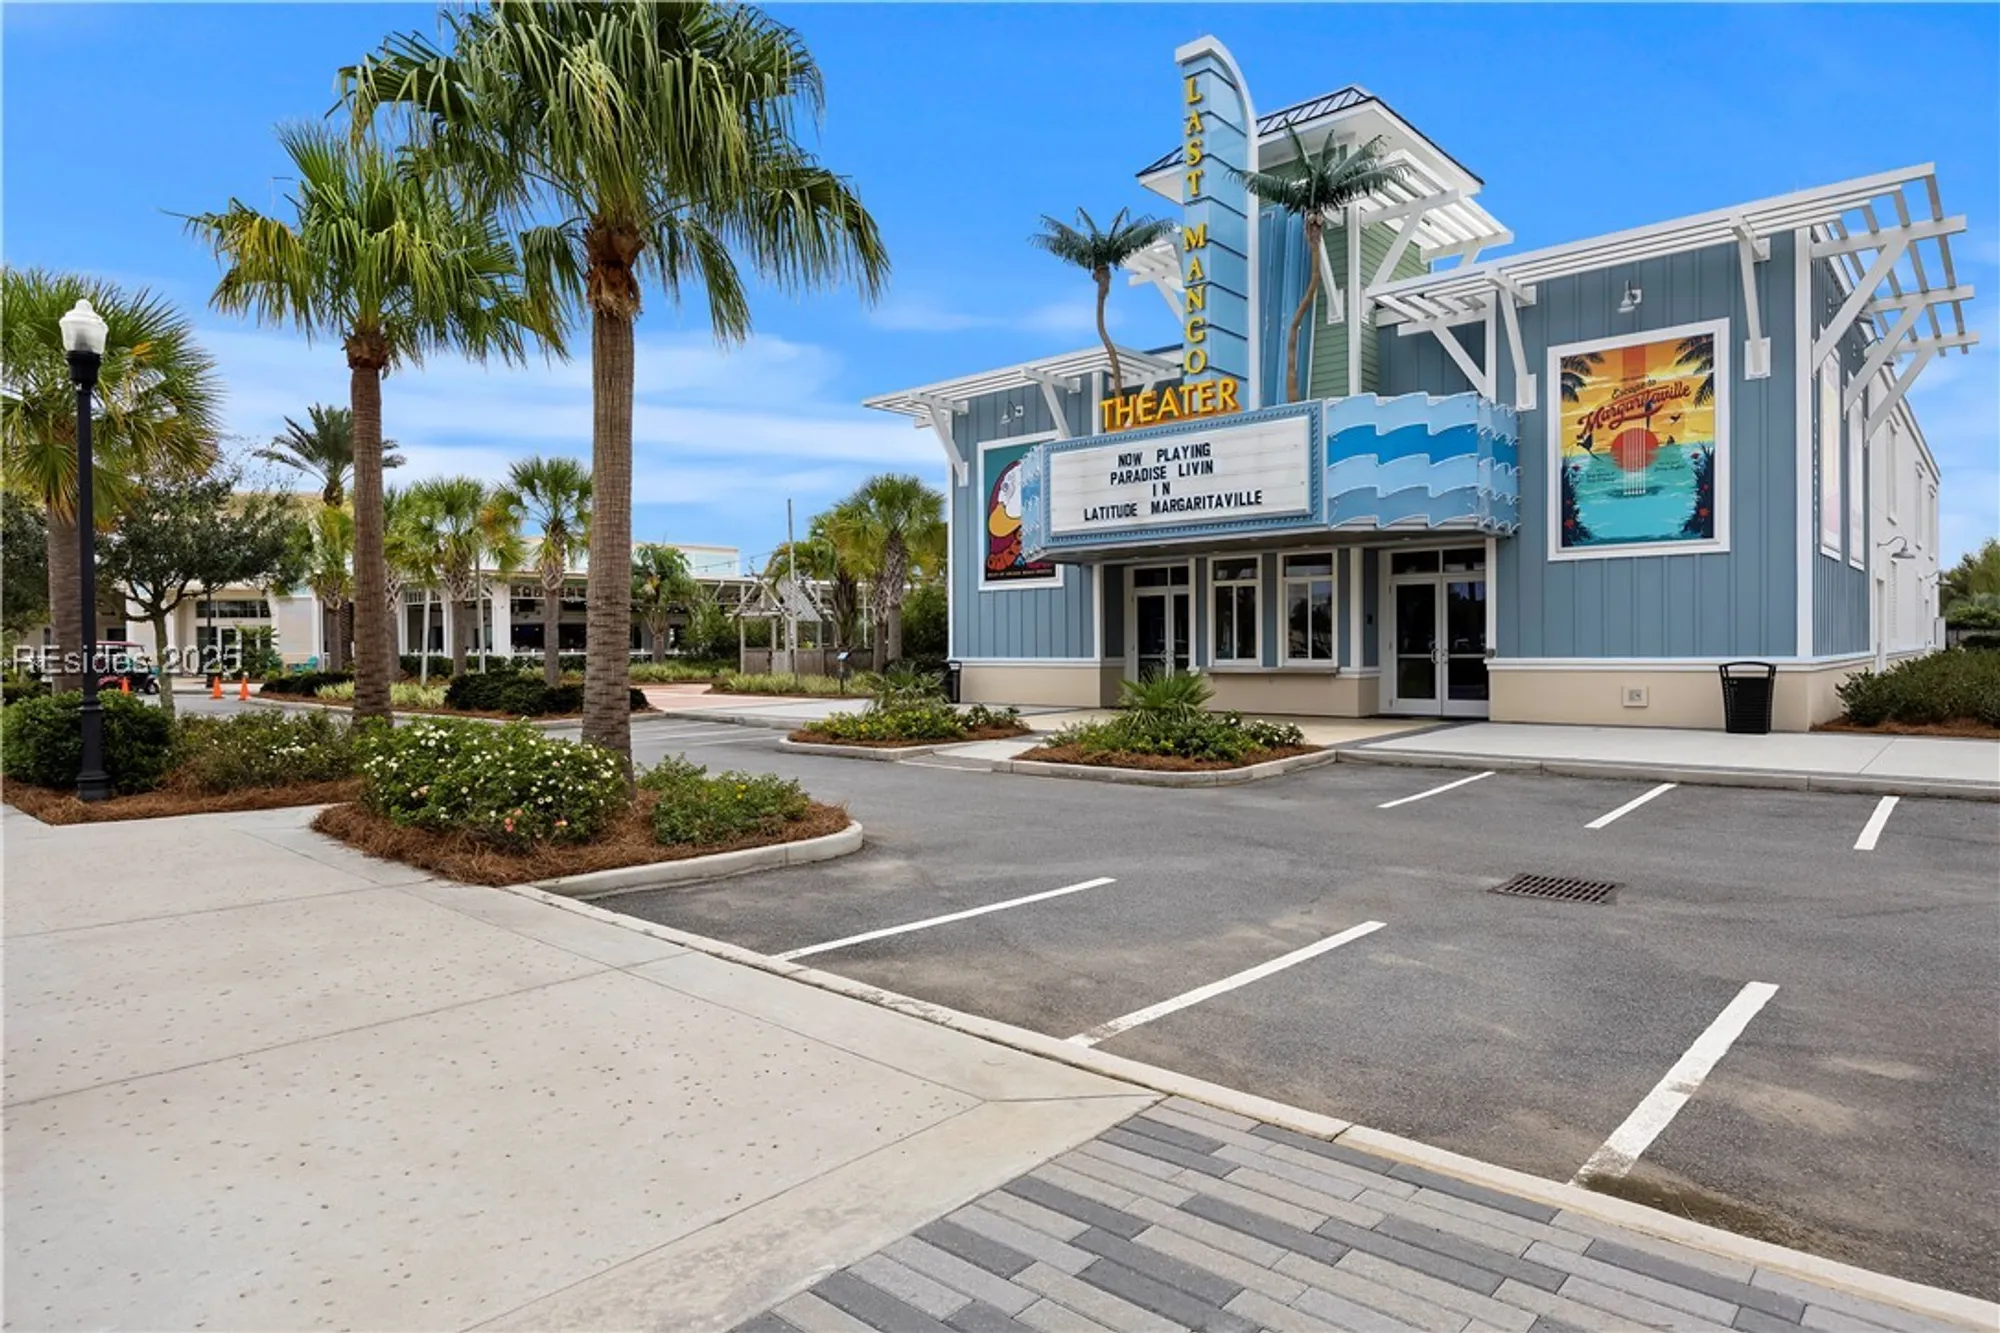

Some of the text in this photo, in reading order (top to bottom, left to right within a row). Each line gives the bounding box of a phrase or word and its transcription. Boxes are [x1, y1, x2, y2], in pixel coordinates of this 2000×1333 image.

[1183, 77, 1207, 375] LAST MANGO
[1100, 376, 1242, 431] THEATER
[1117, 442, 1211, 468] NOW PLAYING
[1110, 459, 1214, 486] PARADISE LIVIN
[1152, 482, 1171, 497] IN
[1084, 490, 1263, 521] LATITUDE MARGARITAVILLE
